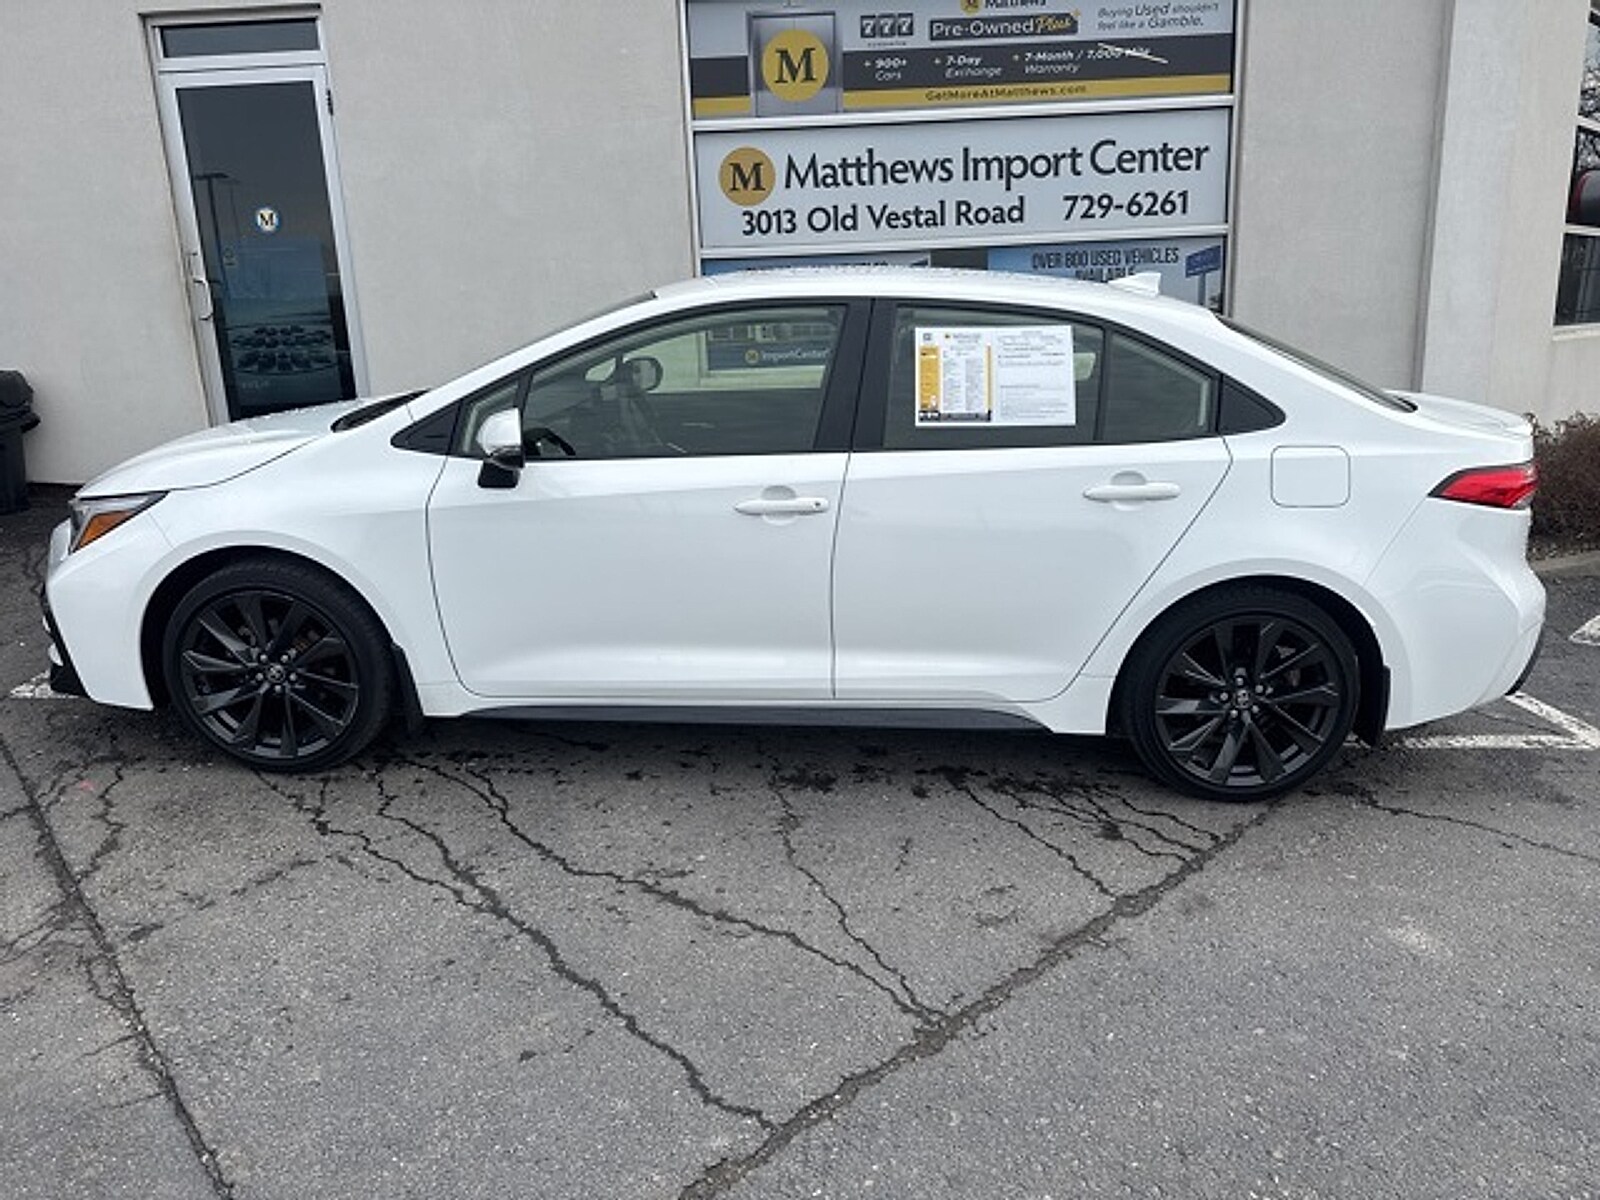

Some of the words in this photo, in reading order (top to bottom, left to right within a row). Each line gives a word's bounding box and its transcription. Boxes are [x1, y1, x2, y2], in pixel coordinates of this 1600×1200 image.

[1135, 3, 1171, 16] Used
[932, 17, 1034, 37] Pre-Owned
[1148, 14, 1204, 29] Gamble.
[774, 47, 818, 84] M
[946, 55, 982, 67] 7-Day
[1024, 62, 1080, 75] Warranty
[875, 70, 902, 81] Cars
[945, 66, 1002, 79] Exchange
[729, 162, 767, 191] M
[785, 147, 954, 189] Matthews
[962, 146, 1083, 192] Import
[1090, 139, 1210, 175] Center
[742, 209, 798, 236] 3013
[807, 203, 859, 232] Old
[867, 199, 947, 230] Vestal
[955, 195, 1026, 227] Road
[1063, 189, 1189, 221] 729-6261
[1032, 252, 1064, 270] OVER
[1090, 248, 1122, 267] USED
[1124, 246, 1180, 266] VEHICLES
